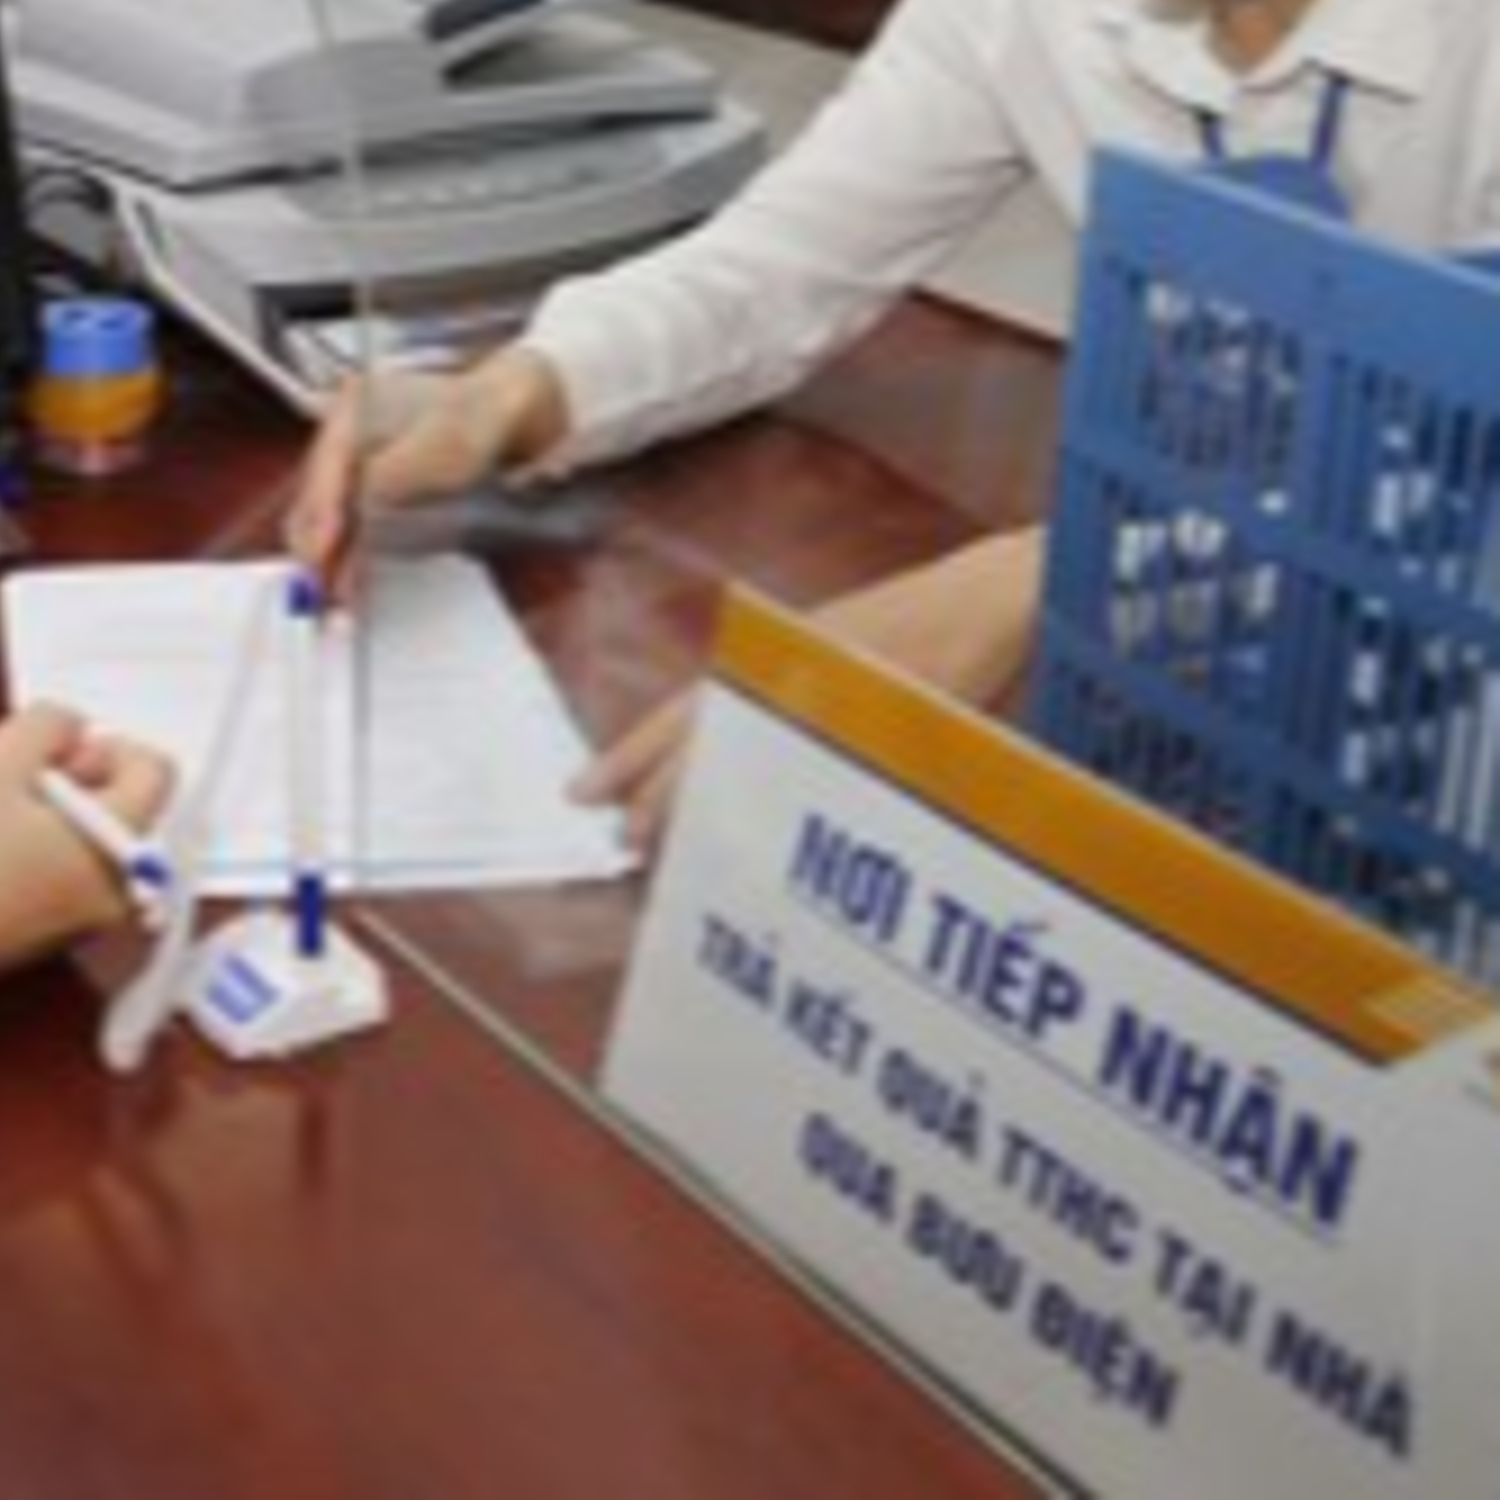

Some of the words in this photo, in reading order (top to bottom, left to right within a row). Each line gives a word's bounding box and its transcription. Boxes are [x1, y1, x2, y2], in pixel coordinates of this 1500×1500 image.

[789, 812, 913, 943] NƠI
[922, 893, 1086, 1039] TIẾP
[1100, 1004, 1358, 1225] NHẬN
[801, 1112, 895, 1222] QUA
[998, 1122, 1141, 1266] TTHC
[1155, 1231, 1257, 1345] TẠI
